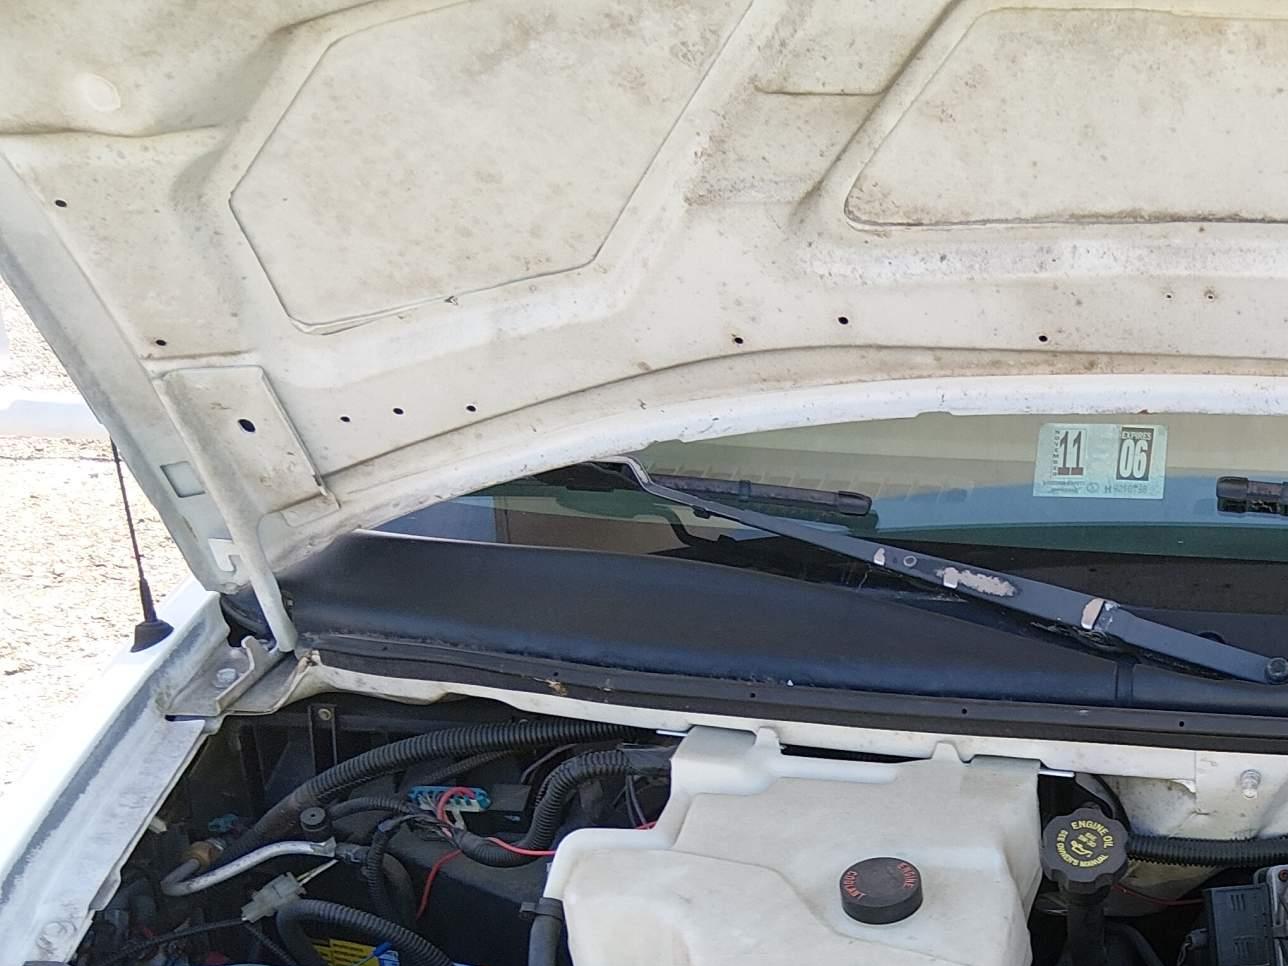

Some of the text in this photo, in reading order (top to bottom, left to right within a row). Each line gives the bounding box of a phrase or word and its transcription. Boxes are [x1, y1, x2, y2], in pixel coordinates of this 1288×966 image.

[1121, 431, 1152, 440] EXPIRES
[1057, 430, 1084, 476] 11
[1119, 439, 1149, 479] 06
[1071, 820, 1109, 836] ENGINE
[1103, 835, 1114, 848] OIL
